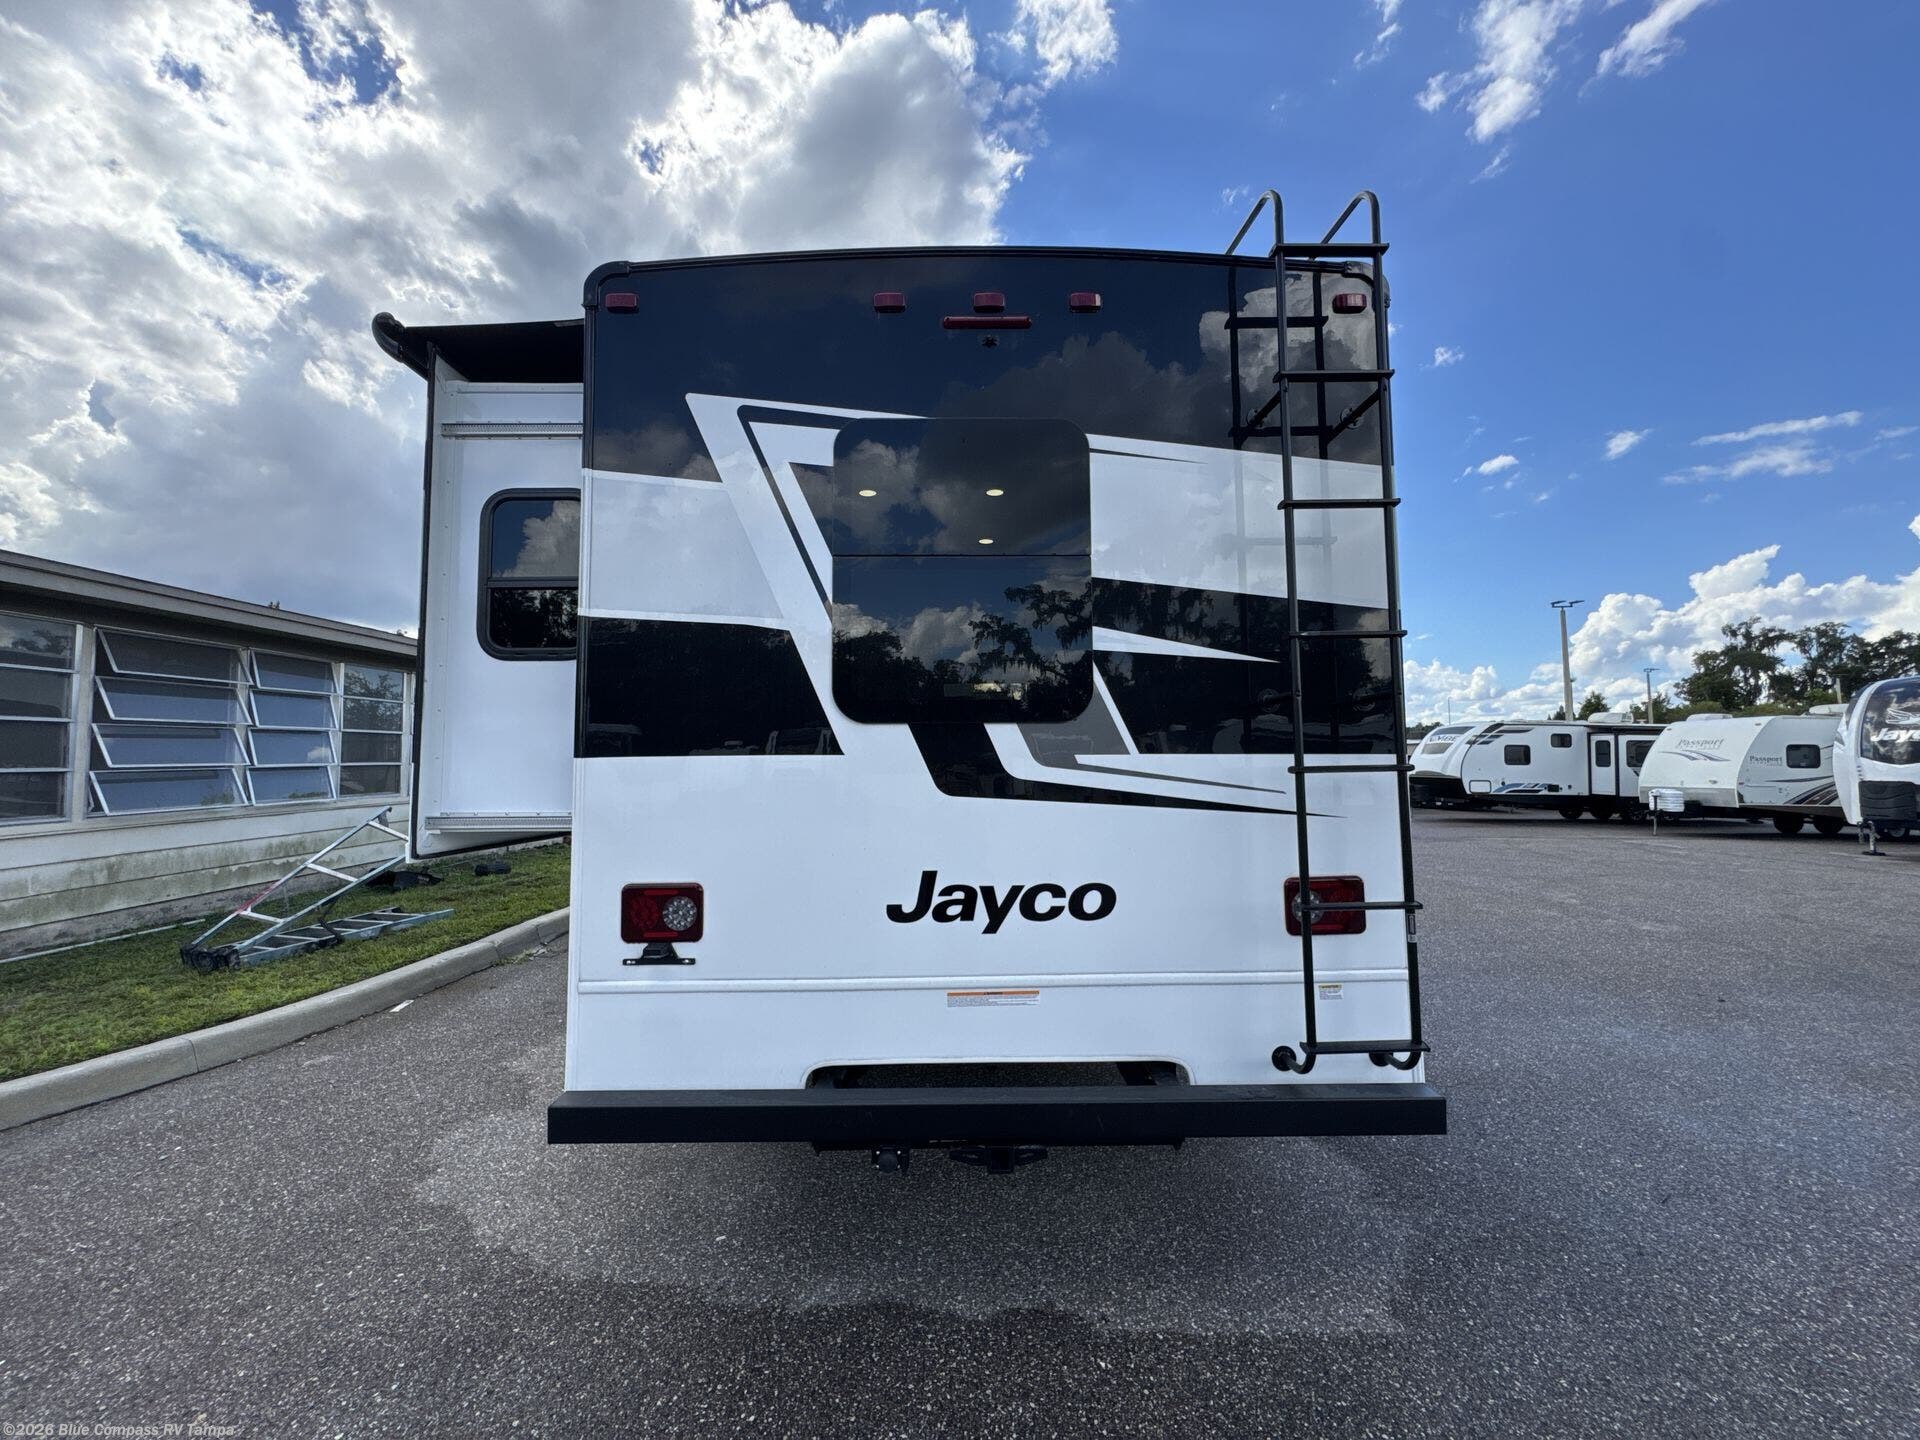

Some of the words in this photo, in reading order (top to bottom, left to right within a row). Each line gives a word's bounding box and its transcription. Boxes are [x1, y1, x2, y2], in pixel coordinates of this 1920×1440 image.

[1870, 727, 1920, 743] Jay
[1678, 738, 1725, 747] Passport
[1749, 755, 1783, 763] Passport
[886, 870, 1117, 934] Jayco
